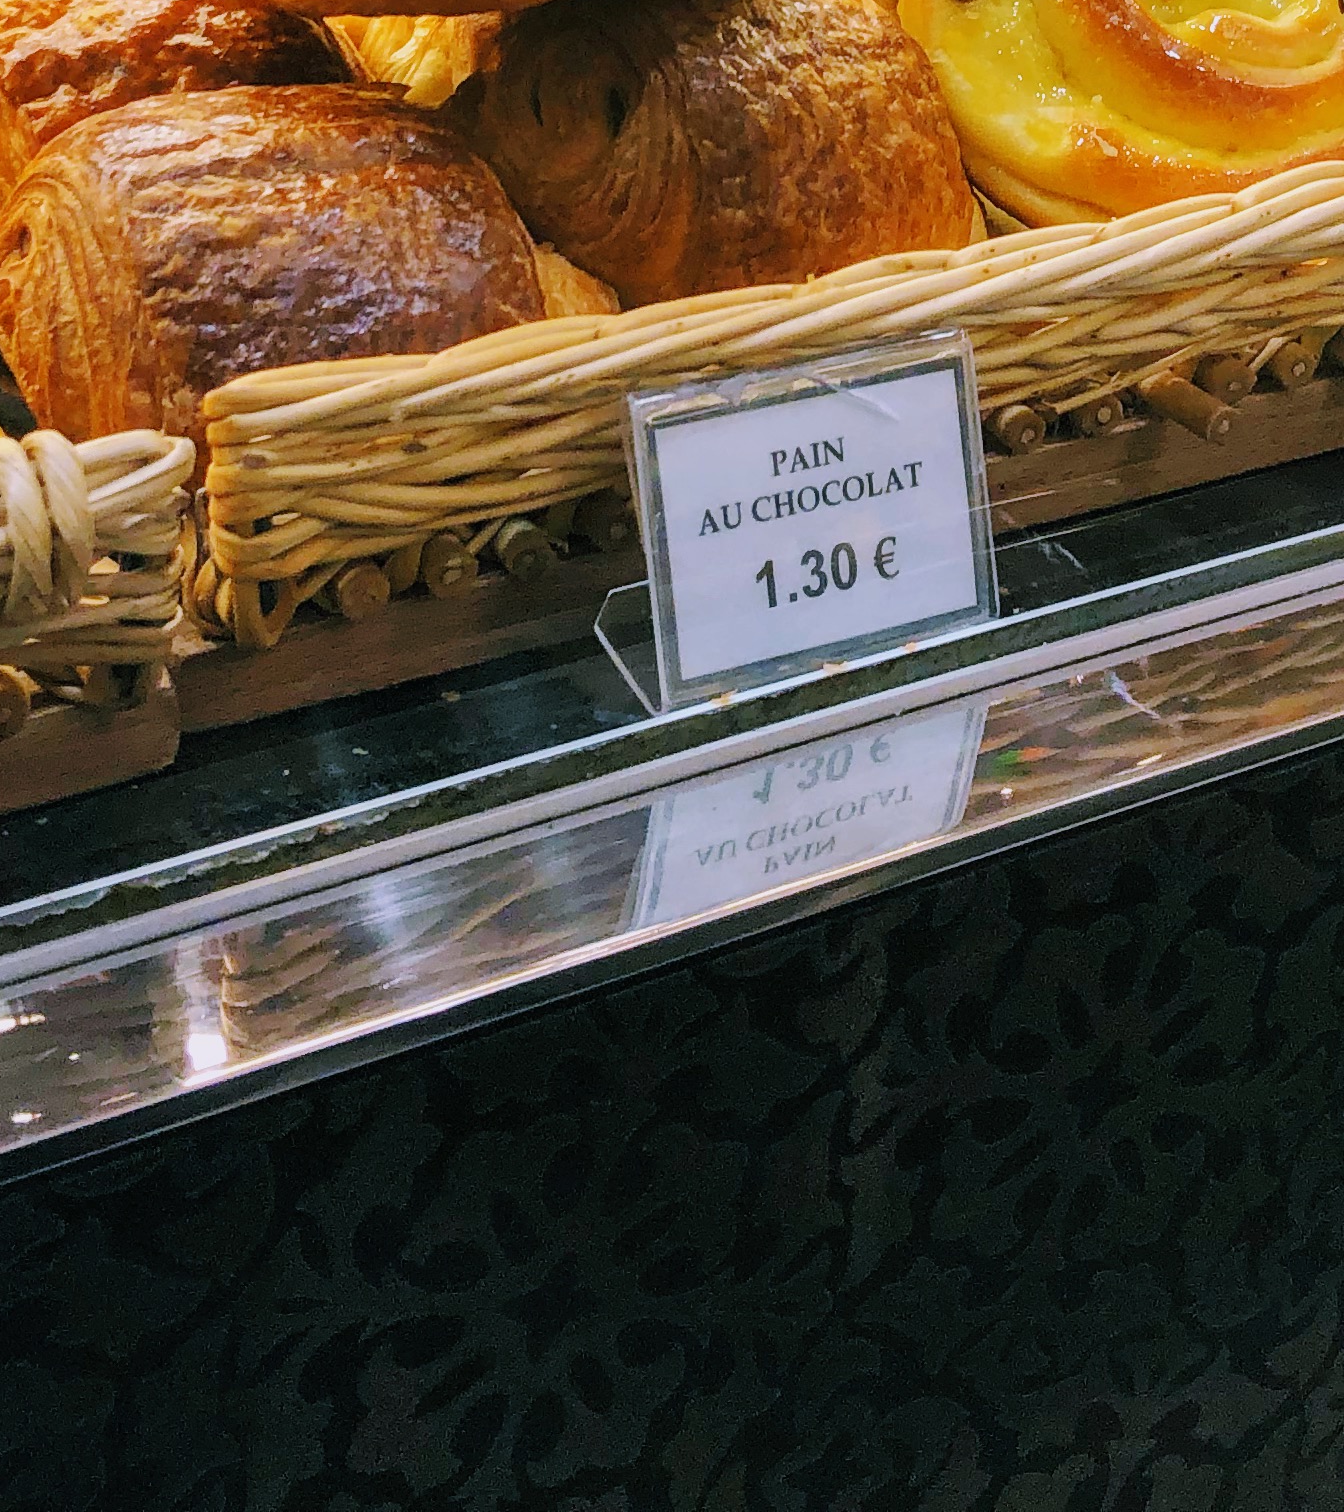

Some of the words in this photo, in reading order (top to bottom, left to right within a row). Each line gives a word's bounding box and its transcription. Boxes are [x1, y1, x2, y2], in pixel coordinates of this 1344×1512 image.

[771, 437, 845, 477] PAIN
[698, 502, 742, 536] AU
[751, 461, 923, 522] CHOCOLAT
[756, 542, 857, 608] 1.30
[873, 536, 900, 580] €
